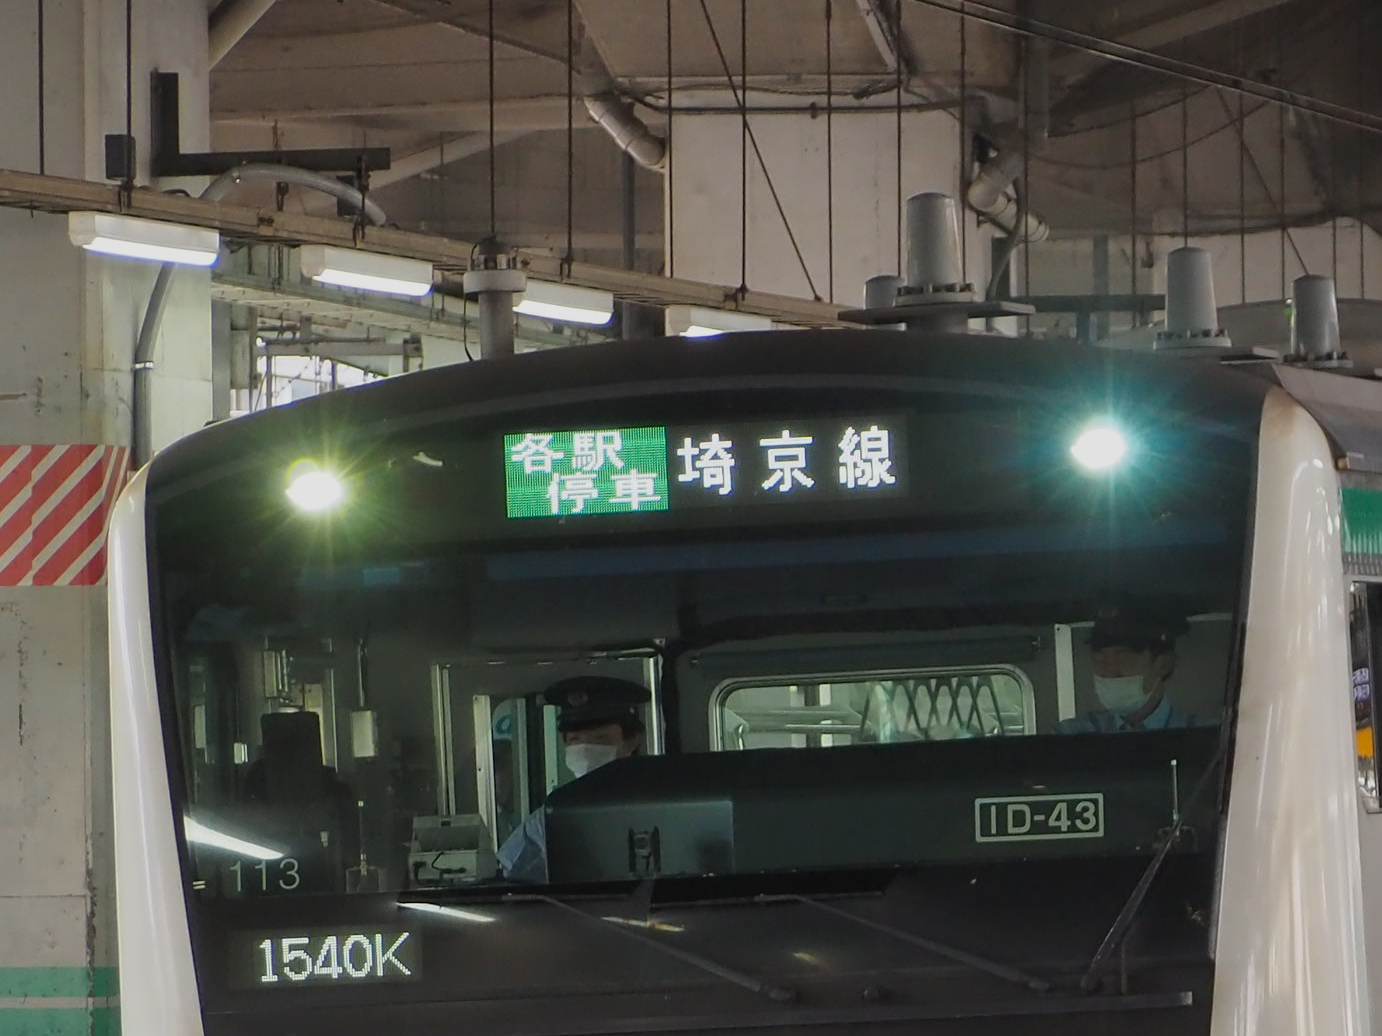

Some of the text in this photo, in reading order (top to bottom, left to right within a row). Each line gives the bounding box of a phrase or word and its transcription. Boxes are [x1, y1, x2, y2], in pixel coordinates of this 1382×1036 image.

[511, 430, 626, 475] 各駅
[676, 424, 897, 496] 埼京線
[546, 469, 662, 515] 停車
[229, 858, 301, 892] 113
[259, 931, 412, 983] 1540K
